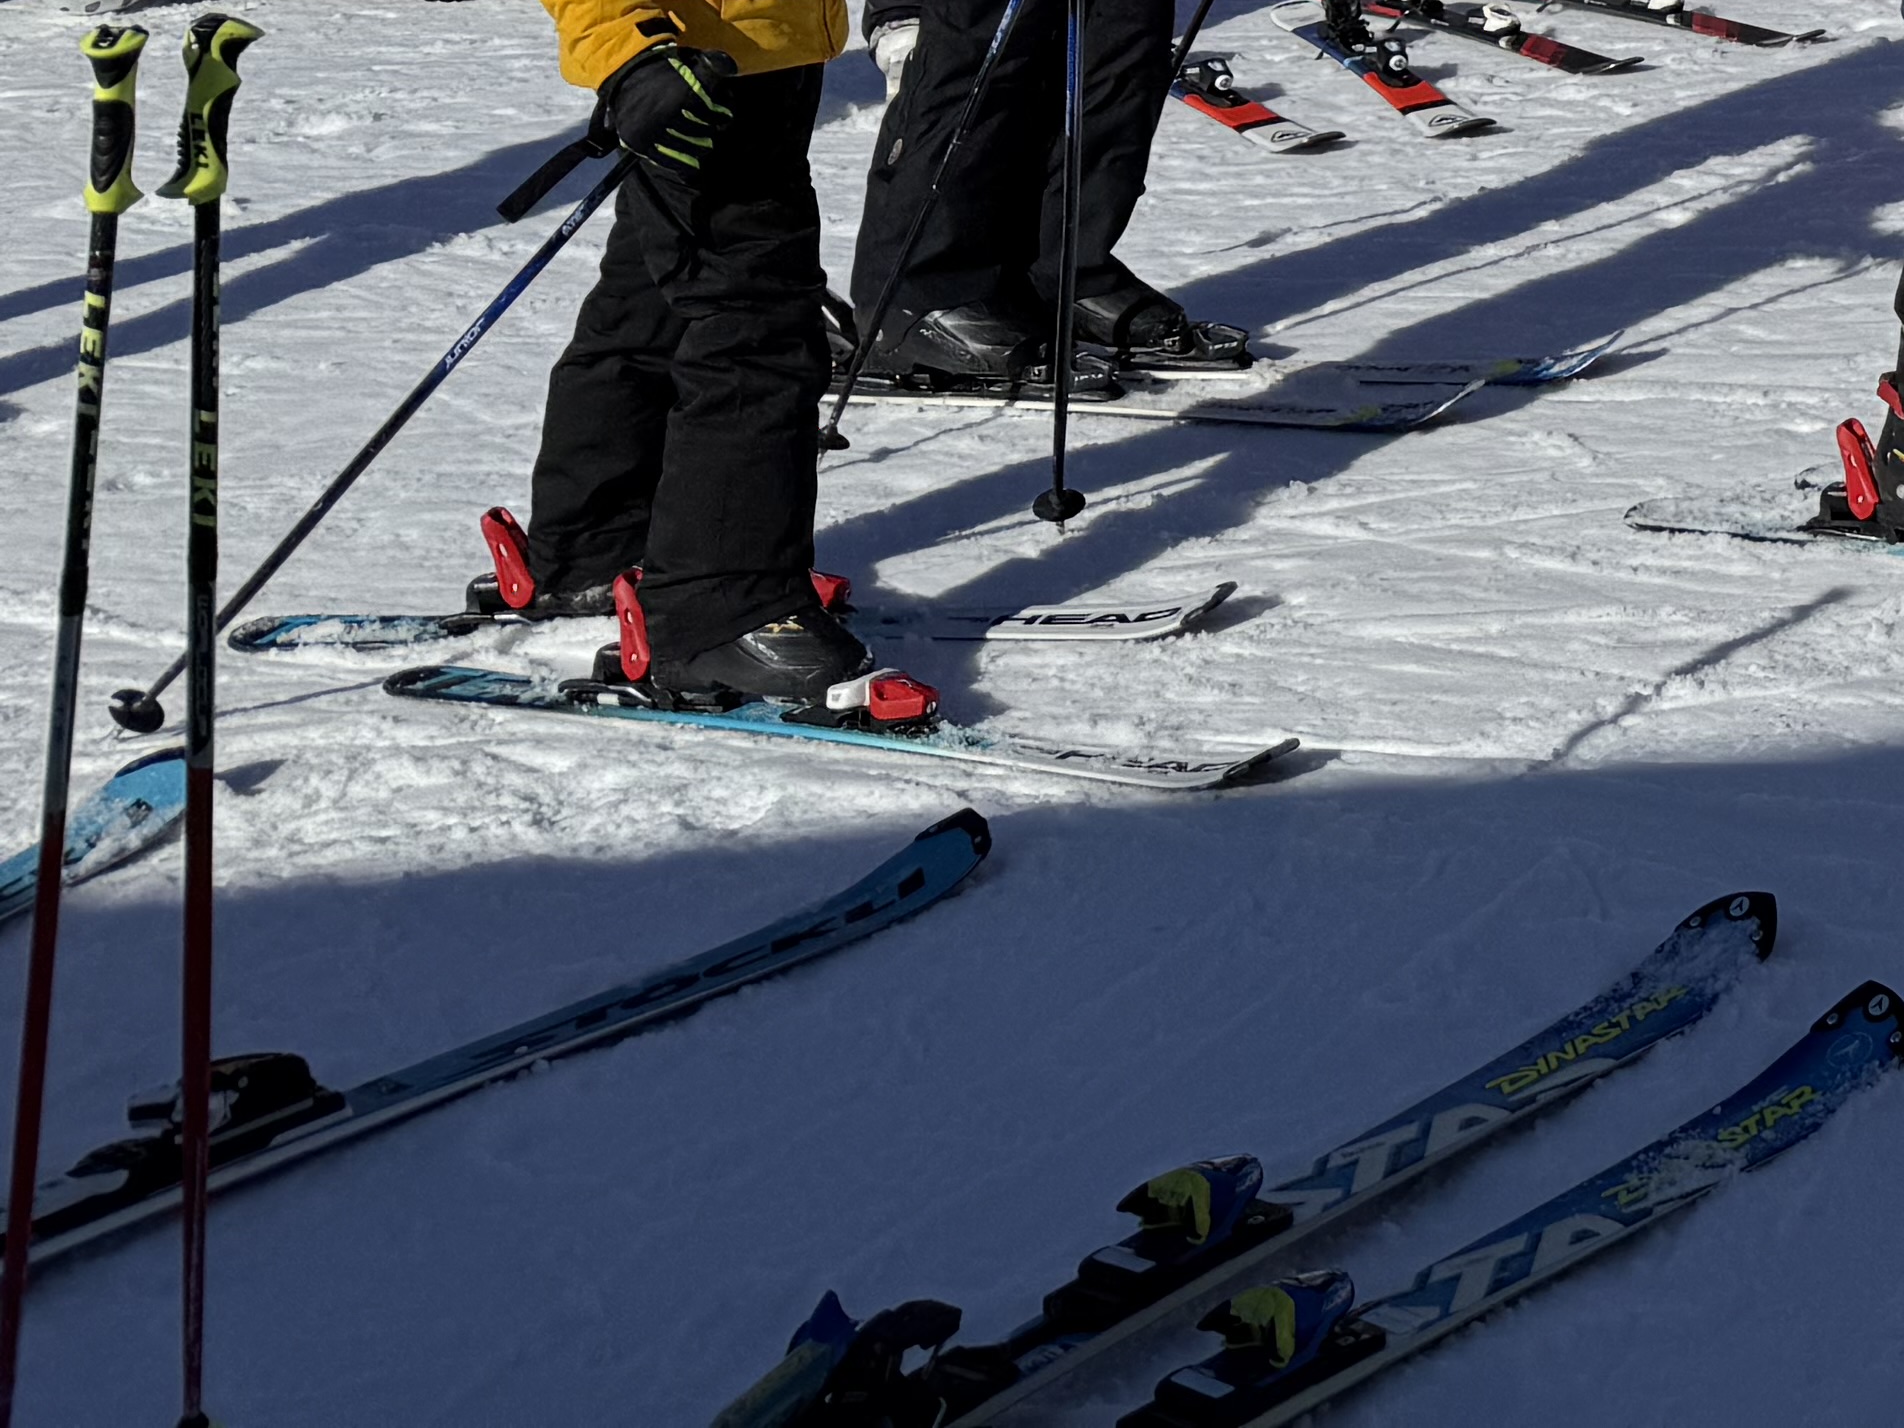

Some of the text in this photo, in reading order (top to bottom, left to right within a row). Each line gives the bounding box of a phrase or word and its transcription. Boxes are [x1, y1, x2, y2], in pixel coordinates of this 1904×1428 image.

[189, 112, 210, 169] LEKI
[78, 290, 106, 415] LEKI
[193, 409, 217, 527] LEKI
[1485, 984, 1693, 1095] DYNASTAR
[1600, 1084, 1823, 1208] DSTAR
